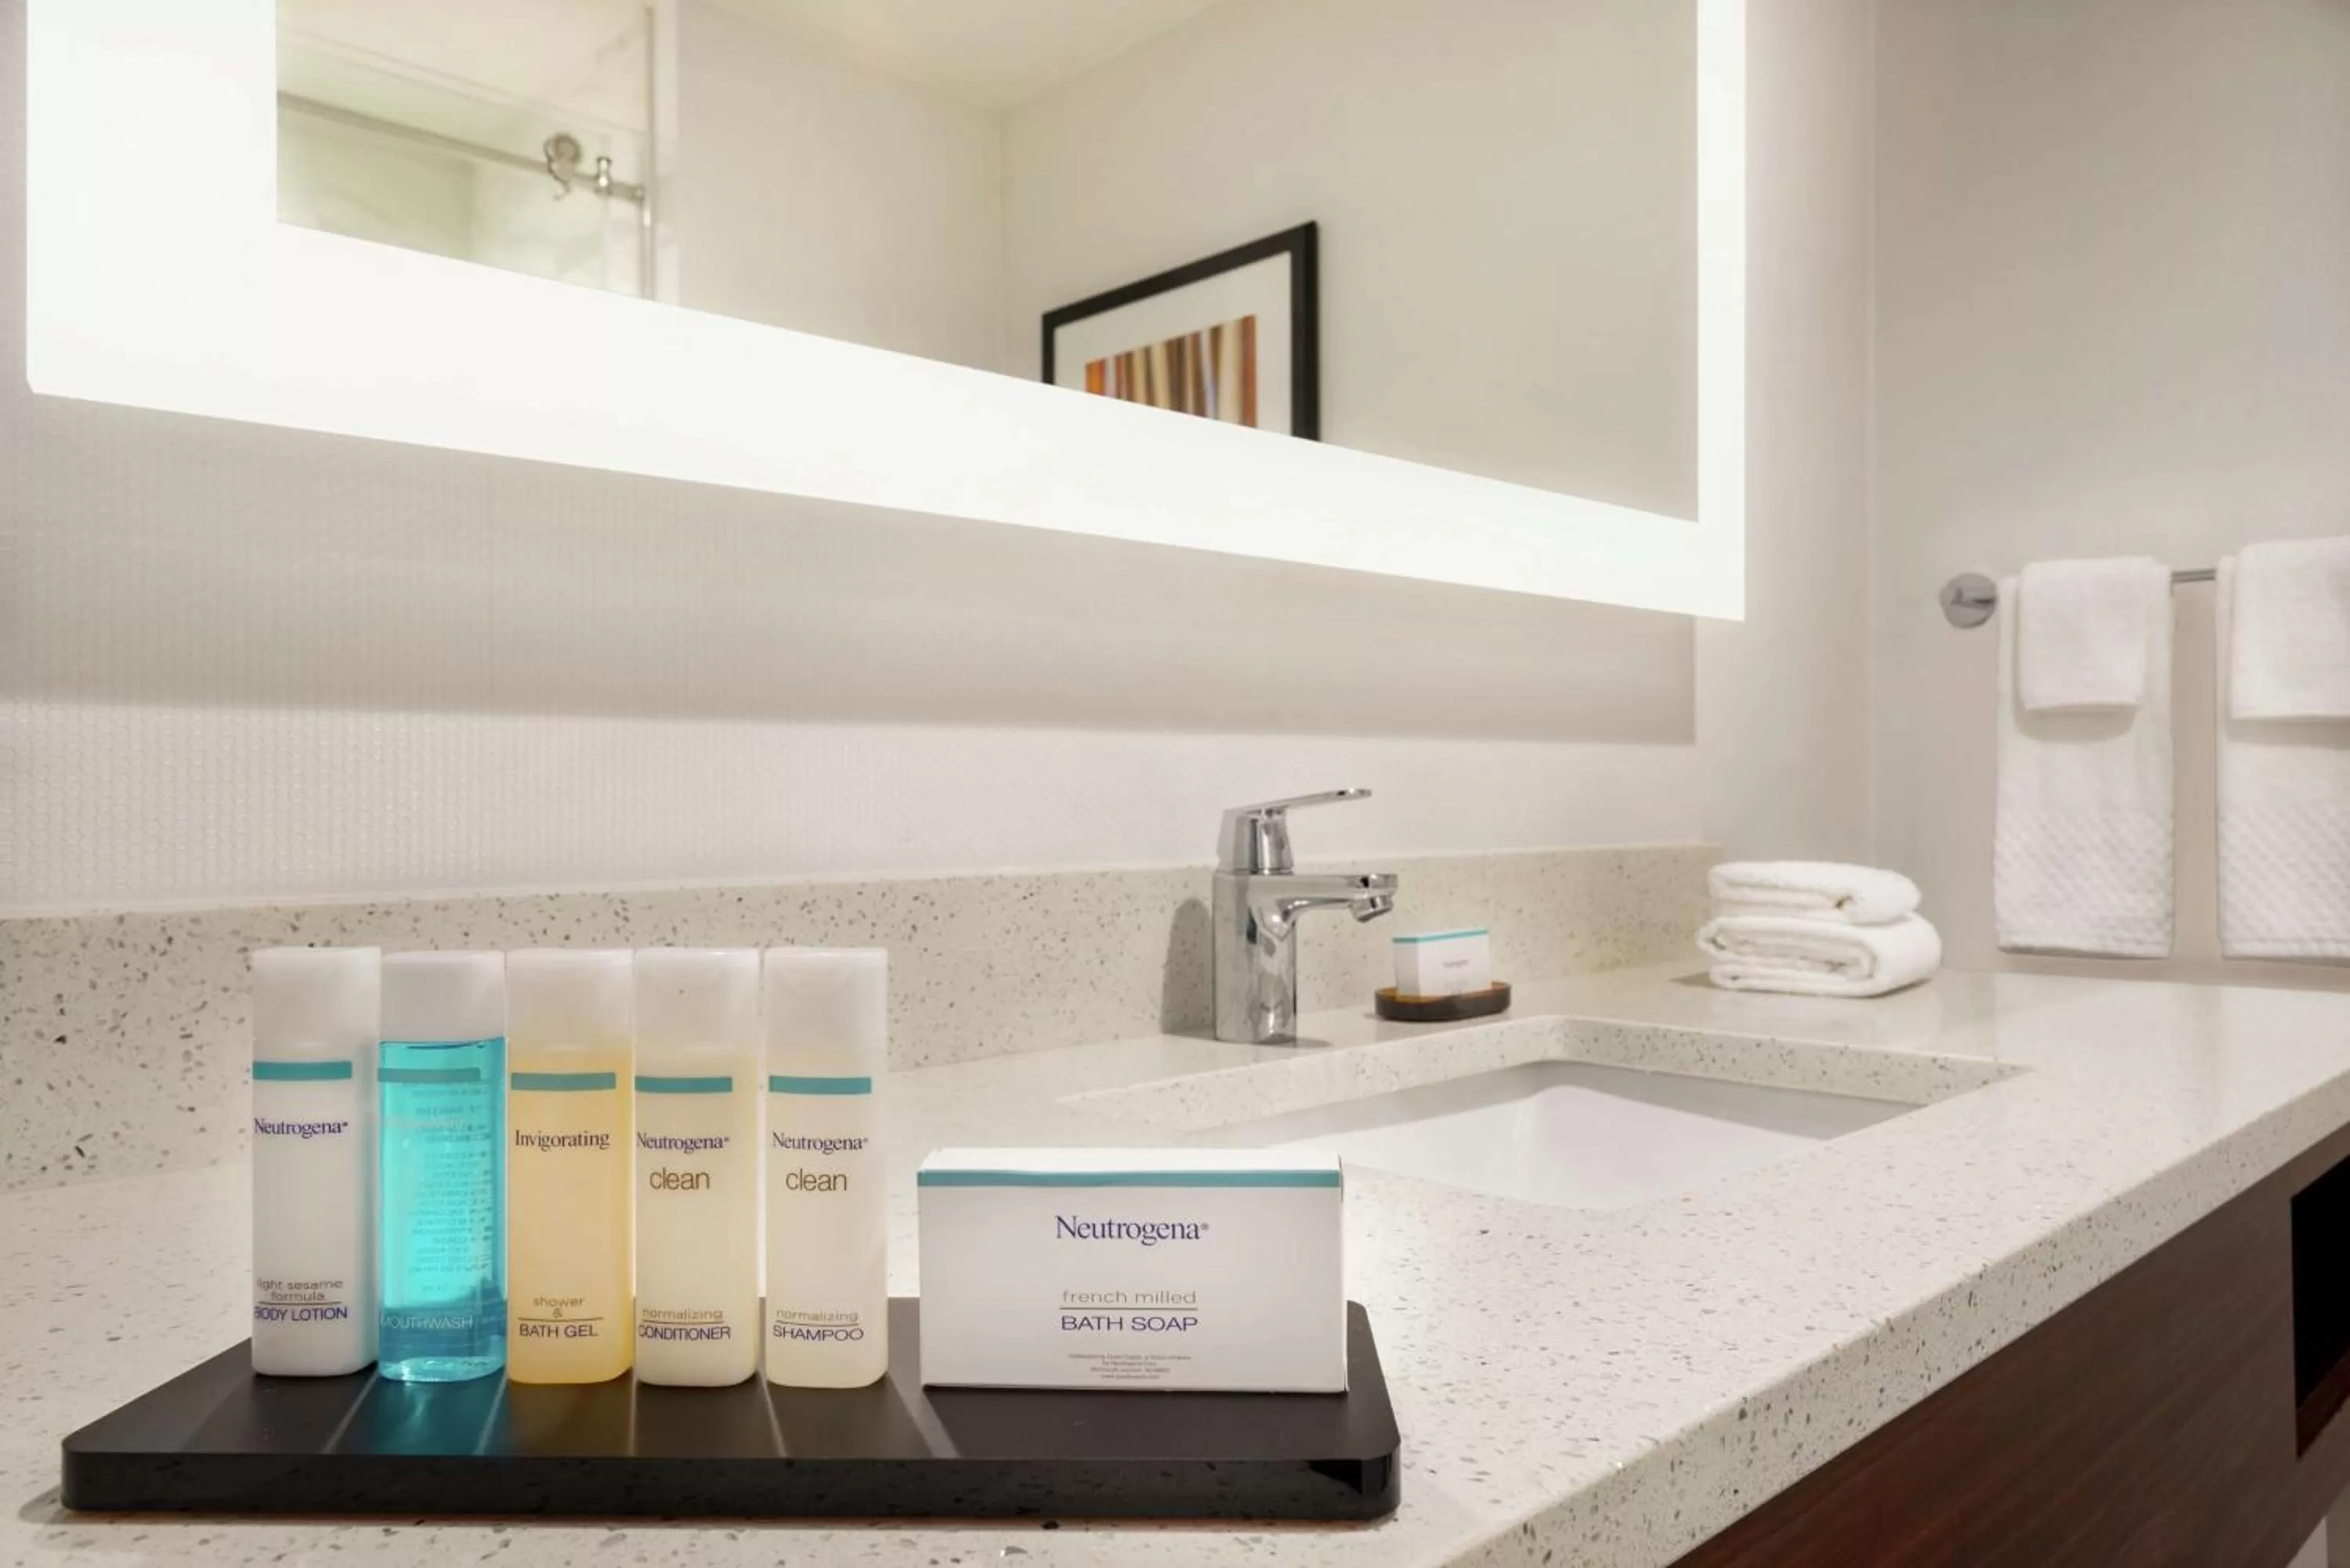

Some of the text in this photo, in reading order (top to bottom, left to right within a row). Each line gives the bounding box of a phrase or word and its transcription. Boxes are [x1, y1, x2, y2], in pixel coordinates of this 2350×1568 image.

[515, 1129, 611, 1152] Invigorating
[649, 1167, 710, 1190] clean
[786, 1168, 848, 1190] clean
[287, 1281, 343, 1291] sesame
[270, 1291, 325, 1301] formula
[533, 1296, 583, 1307] shower
[1063, 1290, 1196, 1304] french milled
[254, 1306, 348, 1322] BODY LOTION
[642, 1309, 724, 1321] normalizing
[776, 1310, 859, 1323] normalizing
[519, 1323, 599, 1339] BATH GEL
[1061, 1316, 1198, 1331] BATH SOAP
[638, 1324, 731, 1341] CONDITIONER
[773, 1324, 864, 1341] SHAMPOO
